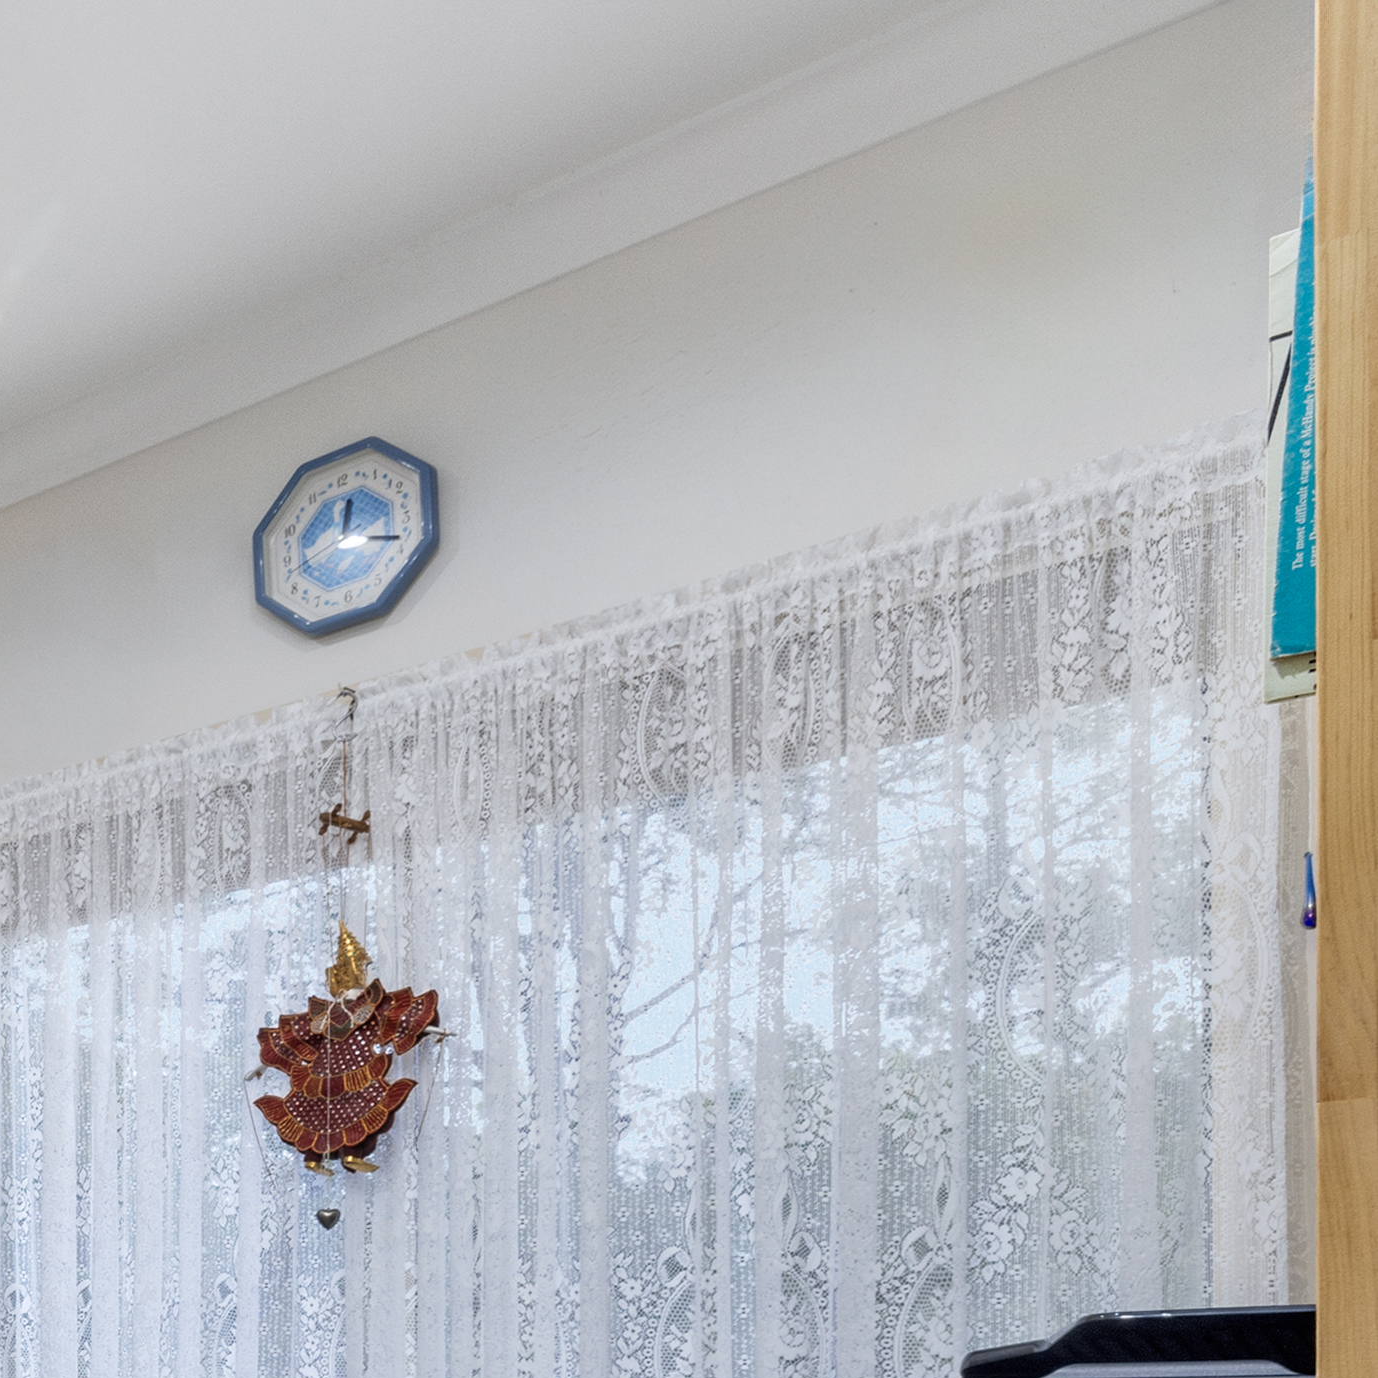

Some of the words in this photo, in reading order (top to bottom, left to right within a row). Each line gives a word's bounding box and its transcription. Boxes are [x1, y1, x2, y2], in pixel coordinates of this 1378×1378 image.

[1300, 447, 1310, 458] of
[372, 469, 377, 479] 1
[1300, 460, 1311, 484] stage
[336, 474, 348, 488] 12
[396, 481, 403, 494] 2
[308, 492, 316, 505] 11
[1295, 486, 1308, 524] difficult
[402, 510, 410, 524] 3
[285, 524, 296, 538] 10
[1295, 526, 1306, 549] most
[397, 544, 403, 554] 4
[284, 556, 291, 567] 9
[1292, 552, 1304, 570] The
[374, 574, 382, 586] 5
[291, 582, 298, 595] 8
[314, 596, 321, 608] 7
[345, 590, 352, 603] 6
